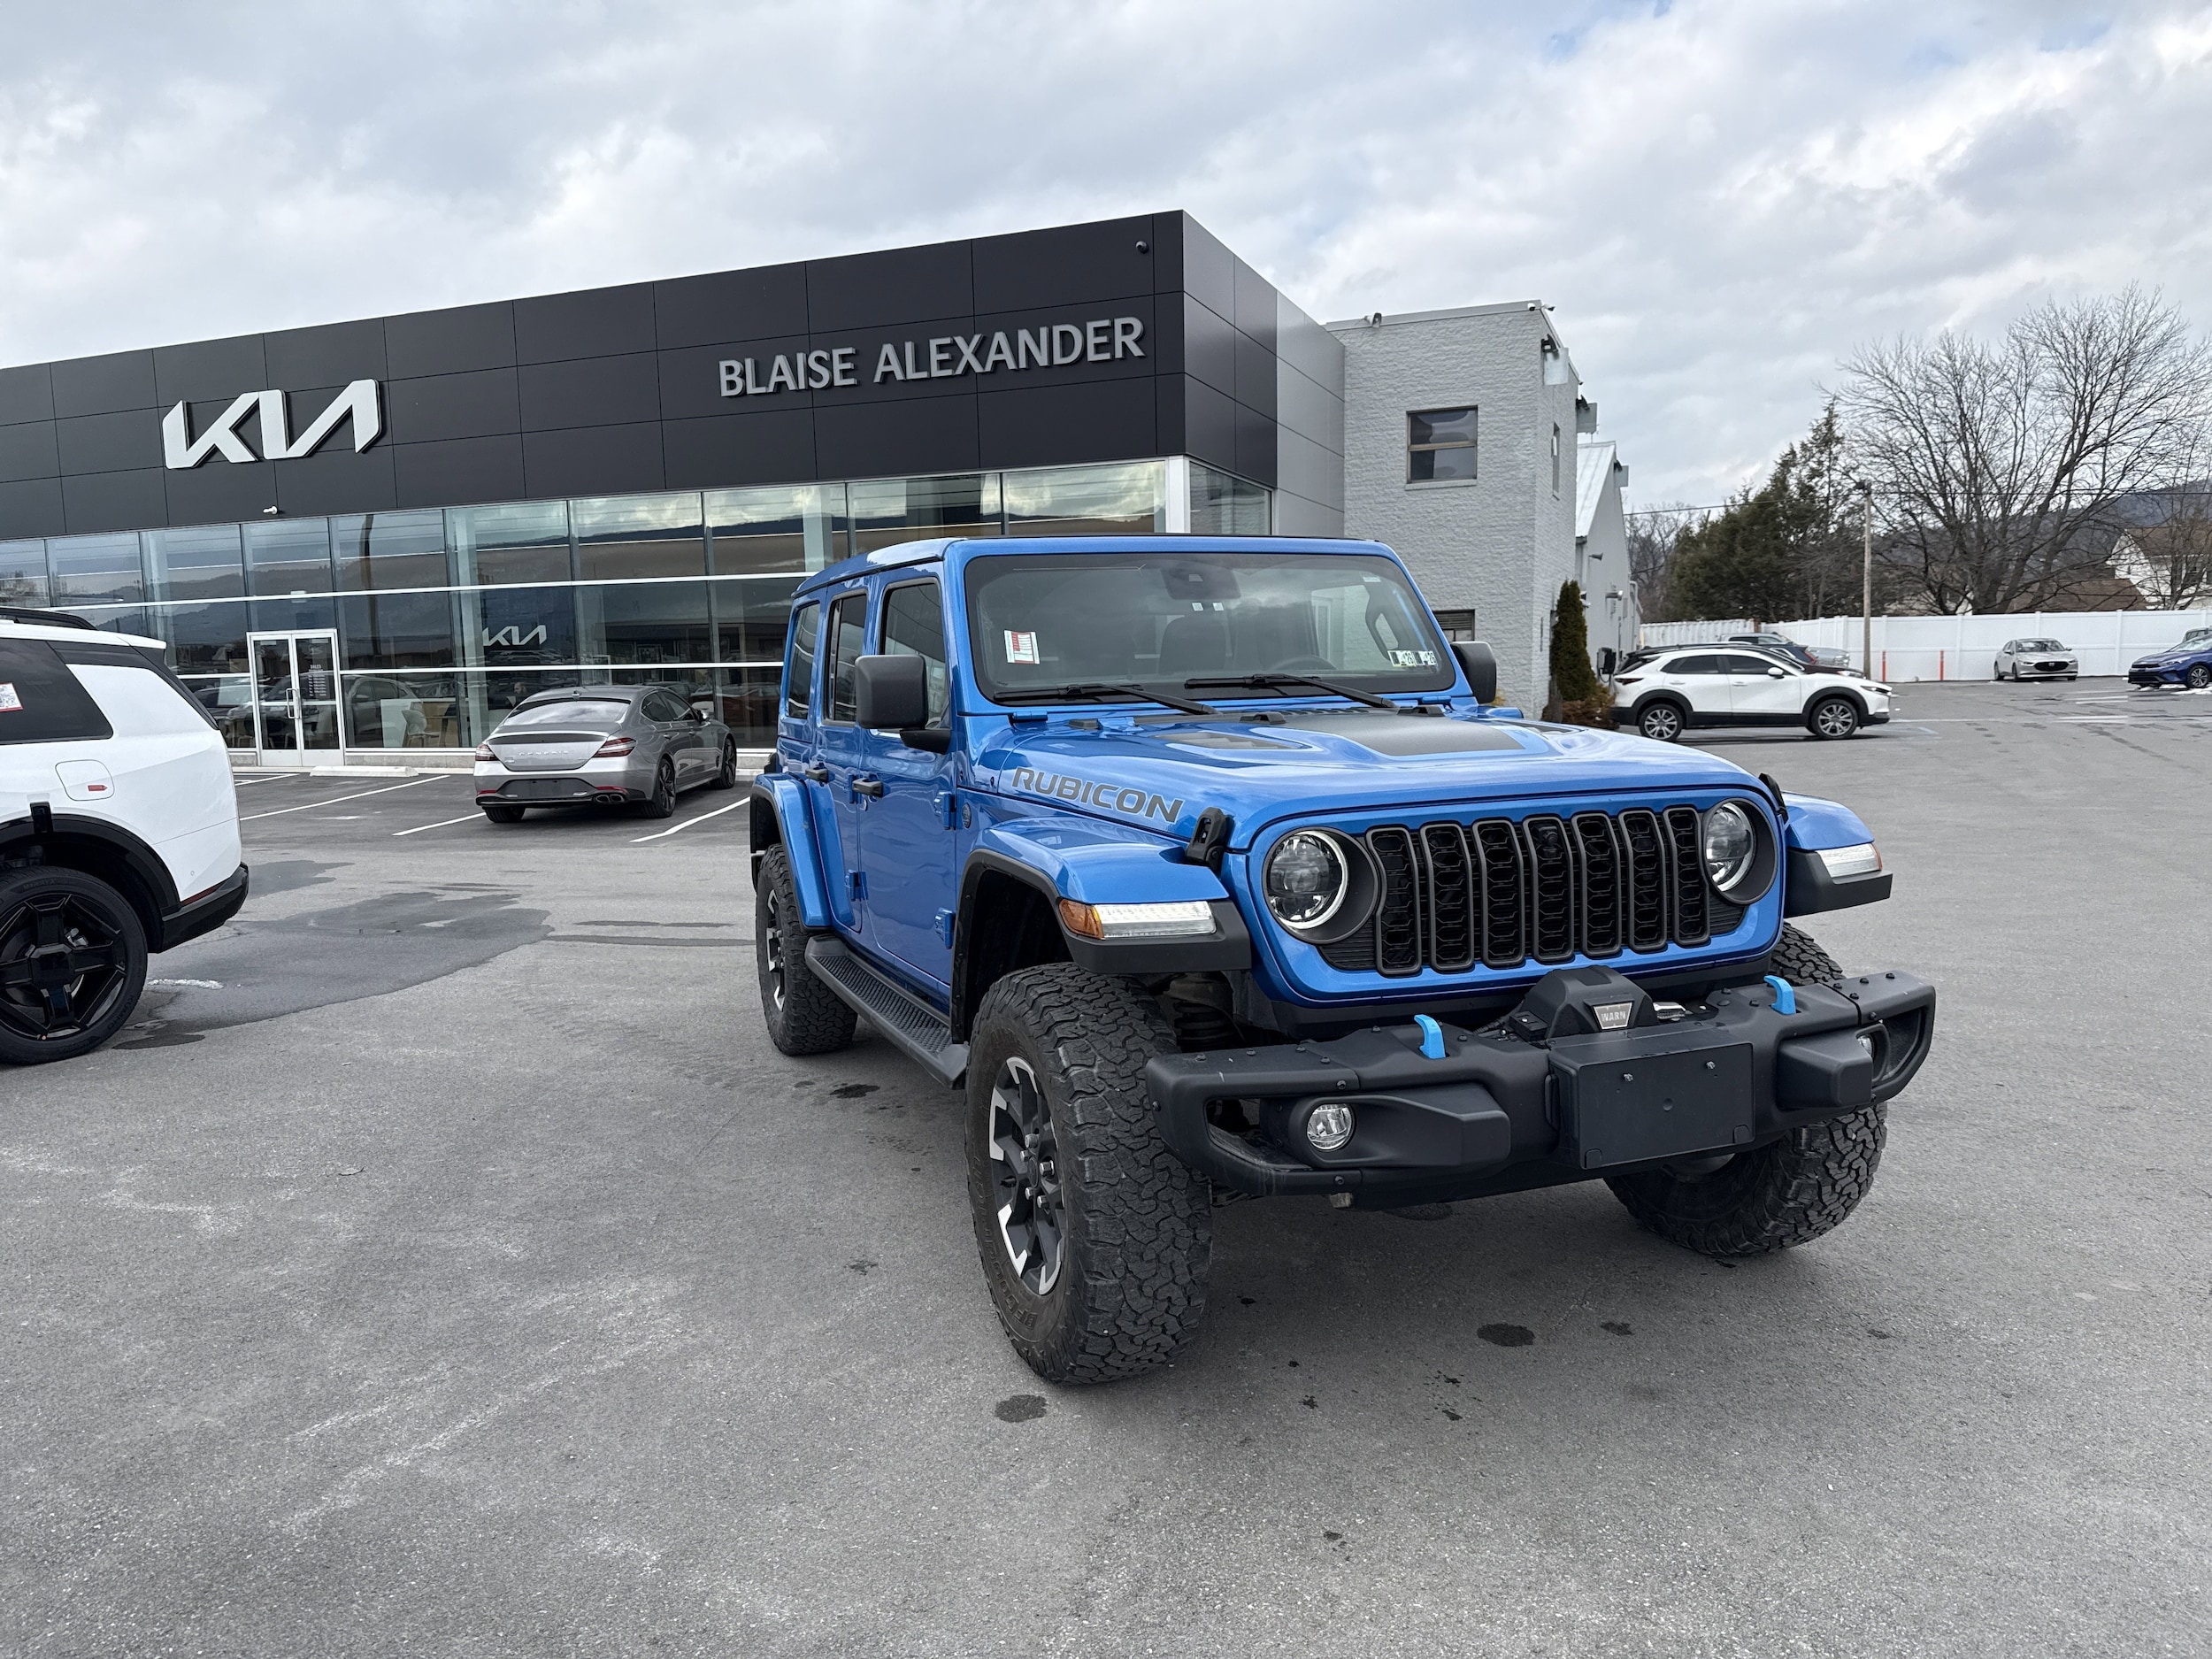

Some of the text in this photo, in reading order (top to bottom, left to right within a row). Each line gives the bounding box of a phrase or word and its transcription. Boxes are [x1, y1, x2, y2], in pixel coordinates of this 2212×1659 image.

[718, 316, 1147, 397] BLAISE ALEXANDER
[162, 379, 382, 470] KIA
[482, 625, 547, 646] KIA
[1011, 766, 1185, 824] RUBICON
[1601, 1011, 1626, 1022] WARN
